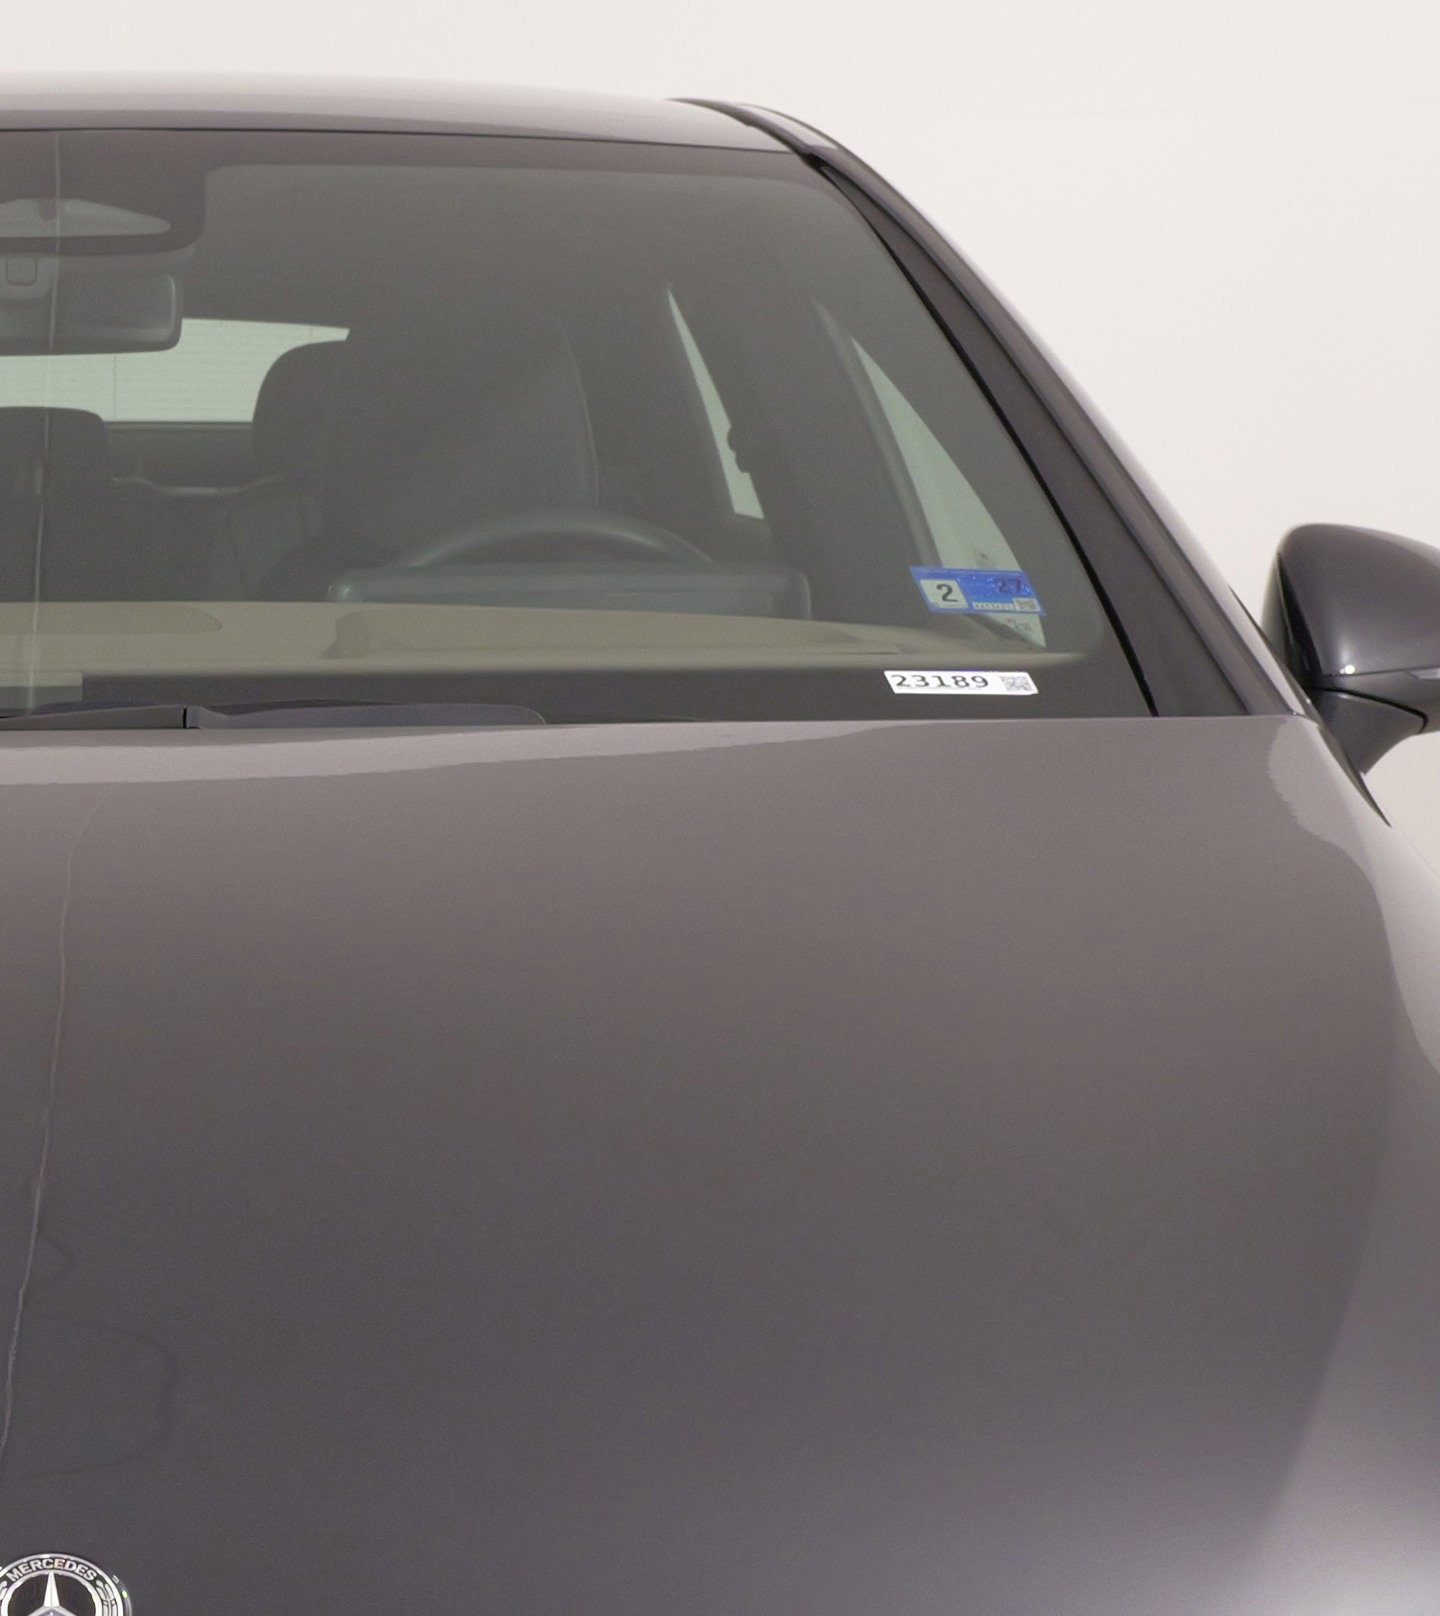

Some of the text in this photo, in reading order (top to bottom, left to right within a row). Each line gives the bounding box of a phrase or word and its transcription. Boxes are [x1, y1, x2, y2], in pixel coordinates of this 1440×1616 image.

[936, 583, 959, 602] 2
[891, 674, 989, 688] 23189
[6, 1558, 98, 1582] MERCEDES
